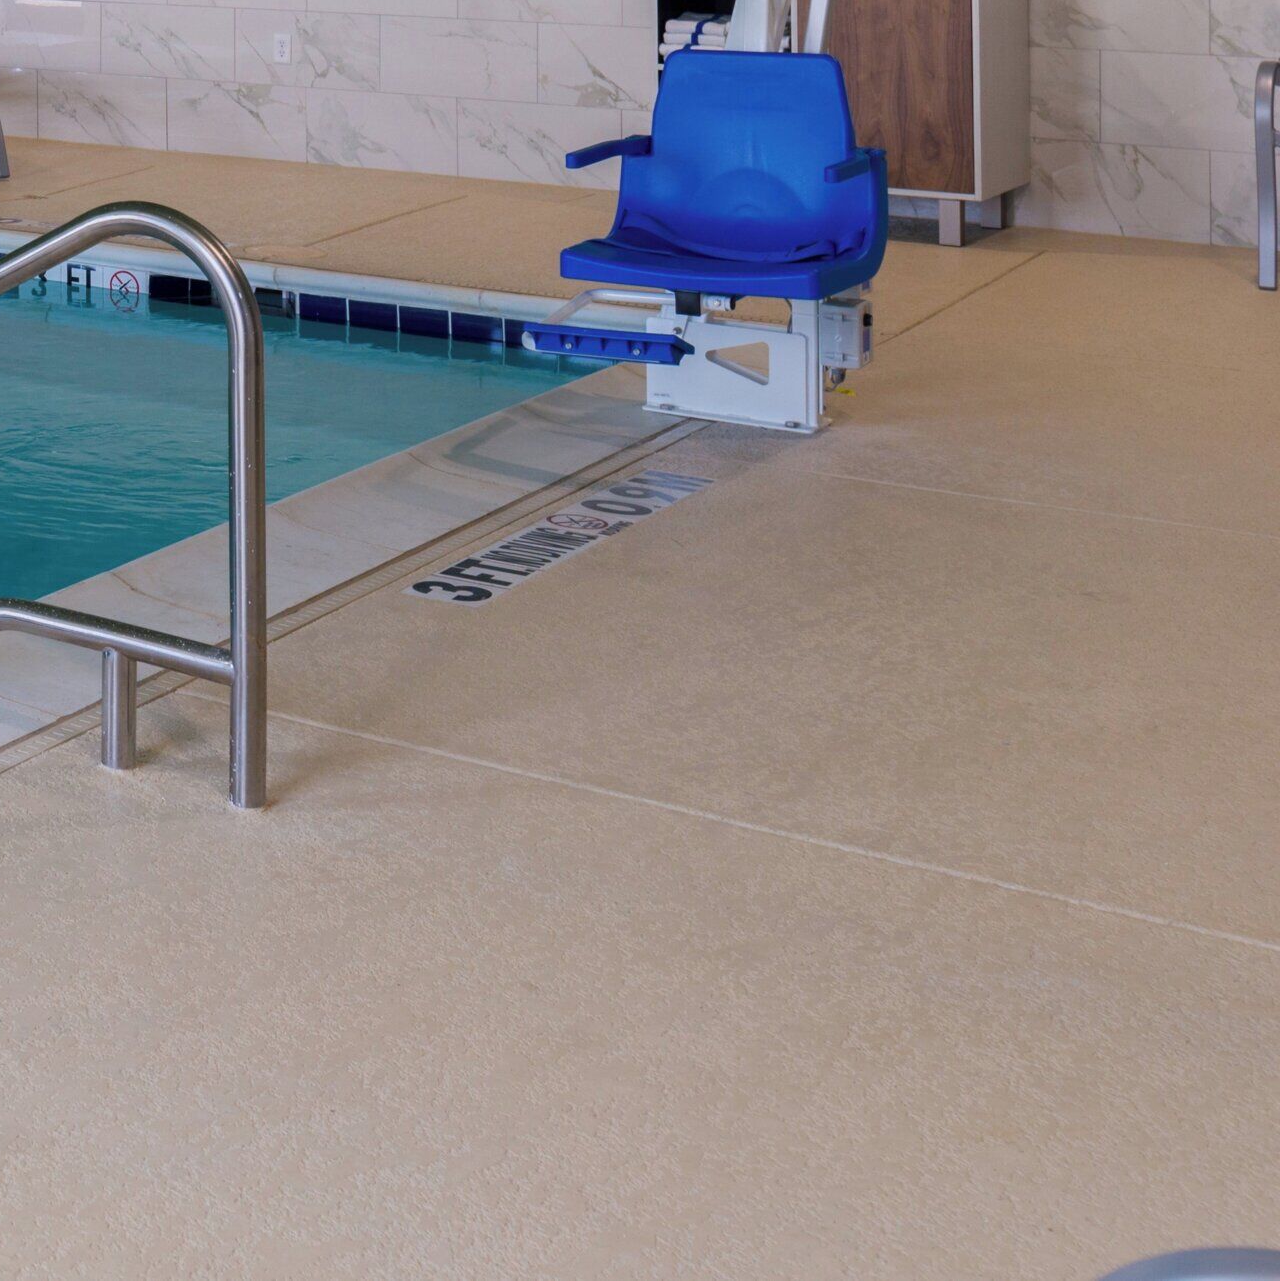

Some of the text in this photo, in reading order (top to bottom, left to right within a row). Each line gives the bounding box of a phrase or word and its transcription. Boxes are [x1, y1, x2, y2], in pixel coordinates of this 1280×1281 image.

[66, 263, 96, 288] FT
[412, 580, 493, 602] 3
[498, 527, 601, 558] DIVING
